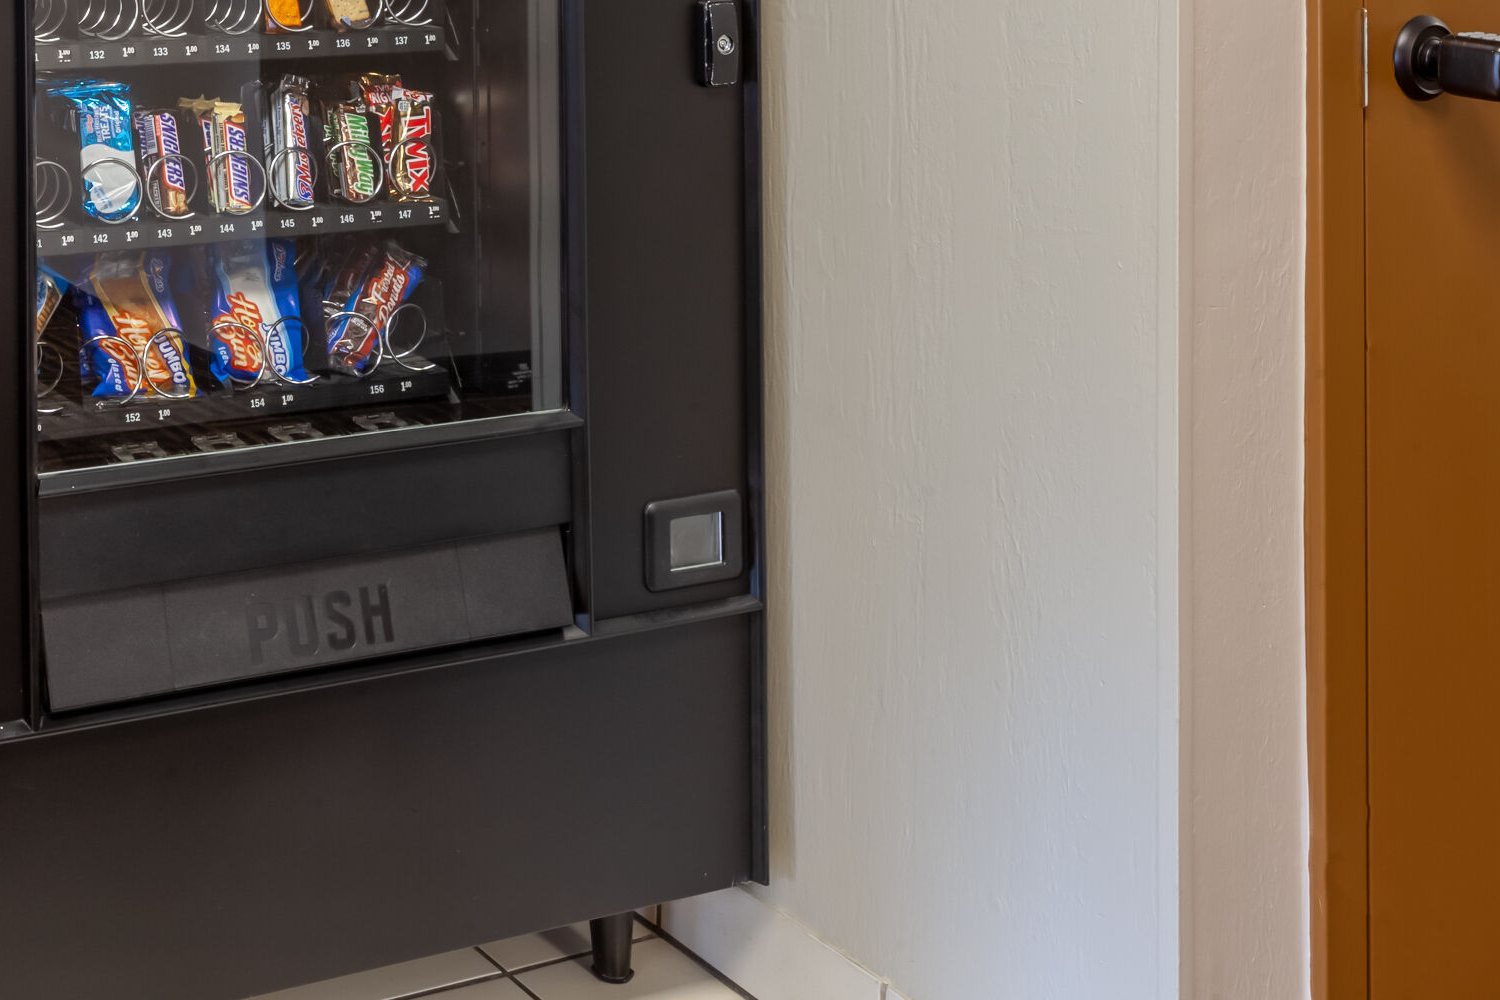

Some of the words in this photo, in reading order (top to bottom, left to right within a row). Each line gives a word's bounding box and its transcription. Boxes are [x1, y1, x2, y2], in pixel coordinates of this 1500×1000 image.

[336, 39, 350, 48] 136
[394, 36, 408, 45] 137
[216, 44, 230, 54] 134
[276, 42, 290, 50] 135
[90, 50, 105, 60] 132
[153, 48, 168, 56] 133
[372, 92, 392, 104] RIG
[100, 106, 112, 142] TREATS
[290, 102, 312, 185] Museteers
[160, 112, 185, 188] SNICKERS
[402, 106, 430, 192] TWIX
[228, 126, 248, 200] SNICKERS
[354, 160, 374, 195] Way
[340, 215, 354, 223] 146
[399, 210, 412, 218] 147
[220, 224, 234, 233] 144
[281, 220, 296, 228] 145
[93, 234, 108, 243] 142
[158, 230, 172, 238] 143
[379, 273, 406, 324] Donuts
[154, 336, 188, 384] JUMBO
[370, 385, 384, 394] 156
[250, 398, 265, 408] 154
[126, 413, 140, 422] 152
[246, 584, 394, 666] PUSH
